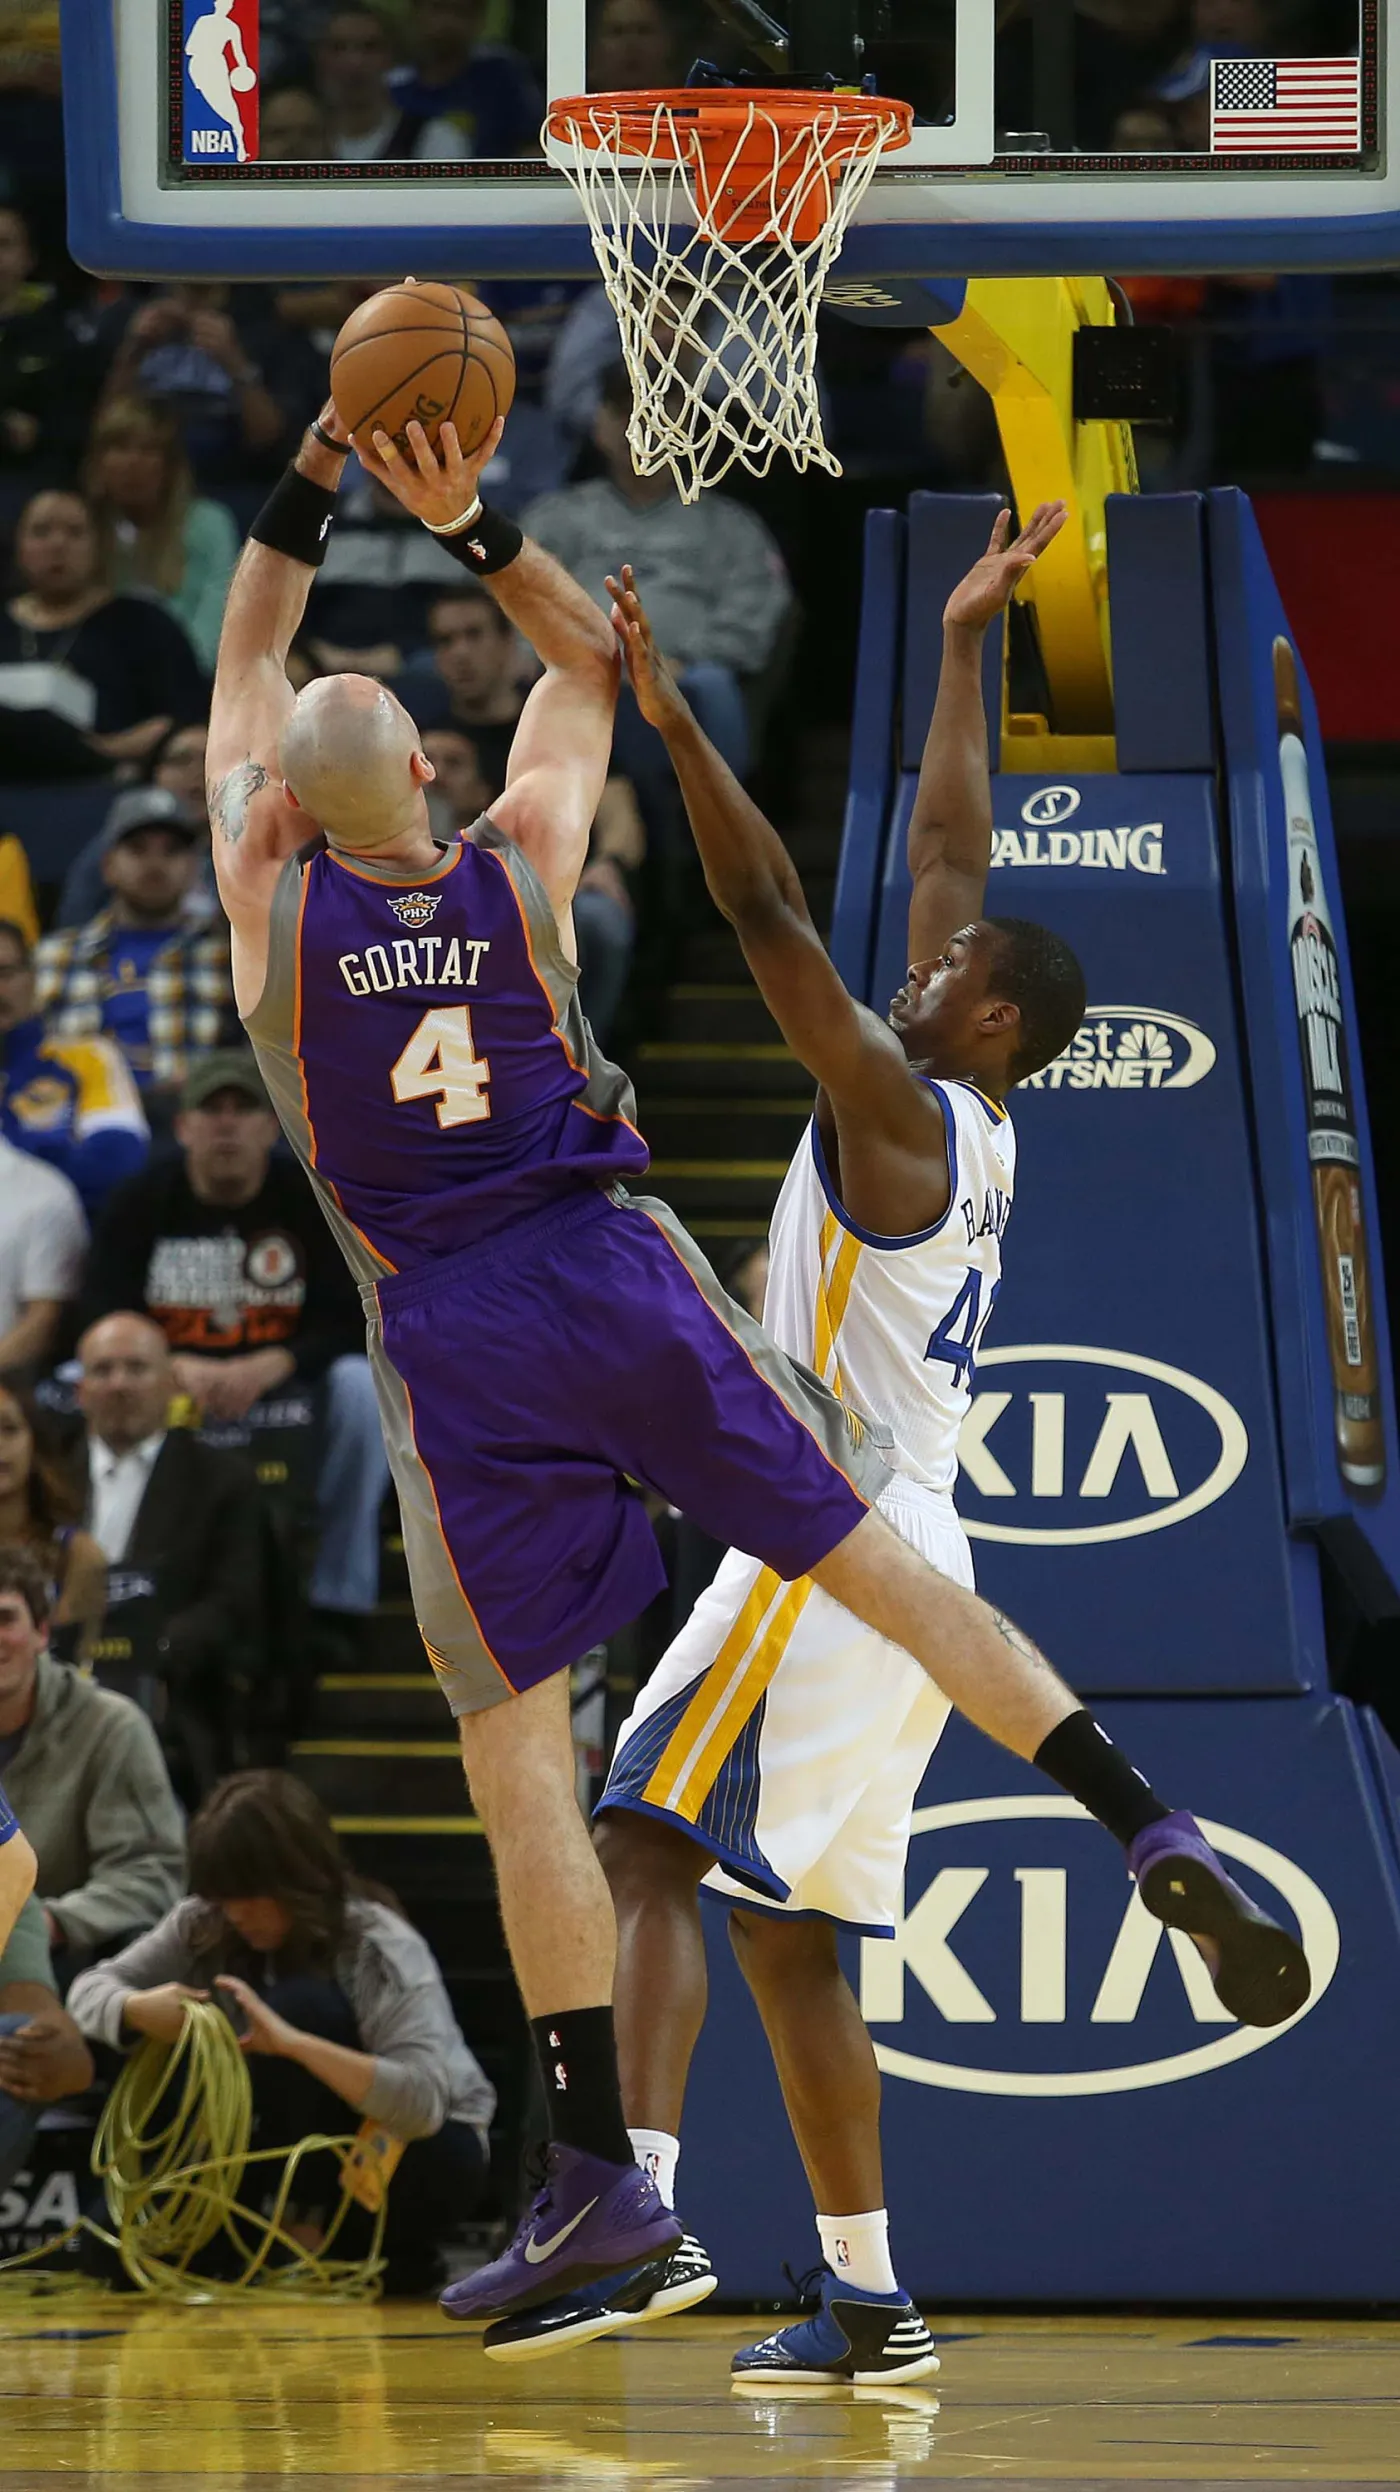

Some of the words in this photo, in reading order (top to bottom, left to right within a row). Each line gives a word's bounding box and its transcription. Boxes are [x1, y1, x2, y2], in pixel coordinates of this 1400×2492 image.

[191, 130, 235, 153] NBA
[338, 936, 490, 996] GORTAT
[402, 907, 430, 919] PHX
[389, 1004, 491, 1131] 4
[924, 1266, 1003, 1394] 4
[954, 1392, 1180, 1499] KIA
[859, 1866, 1240, 2024] KIA
